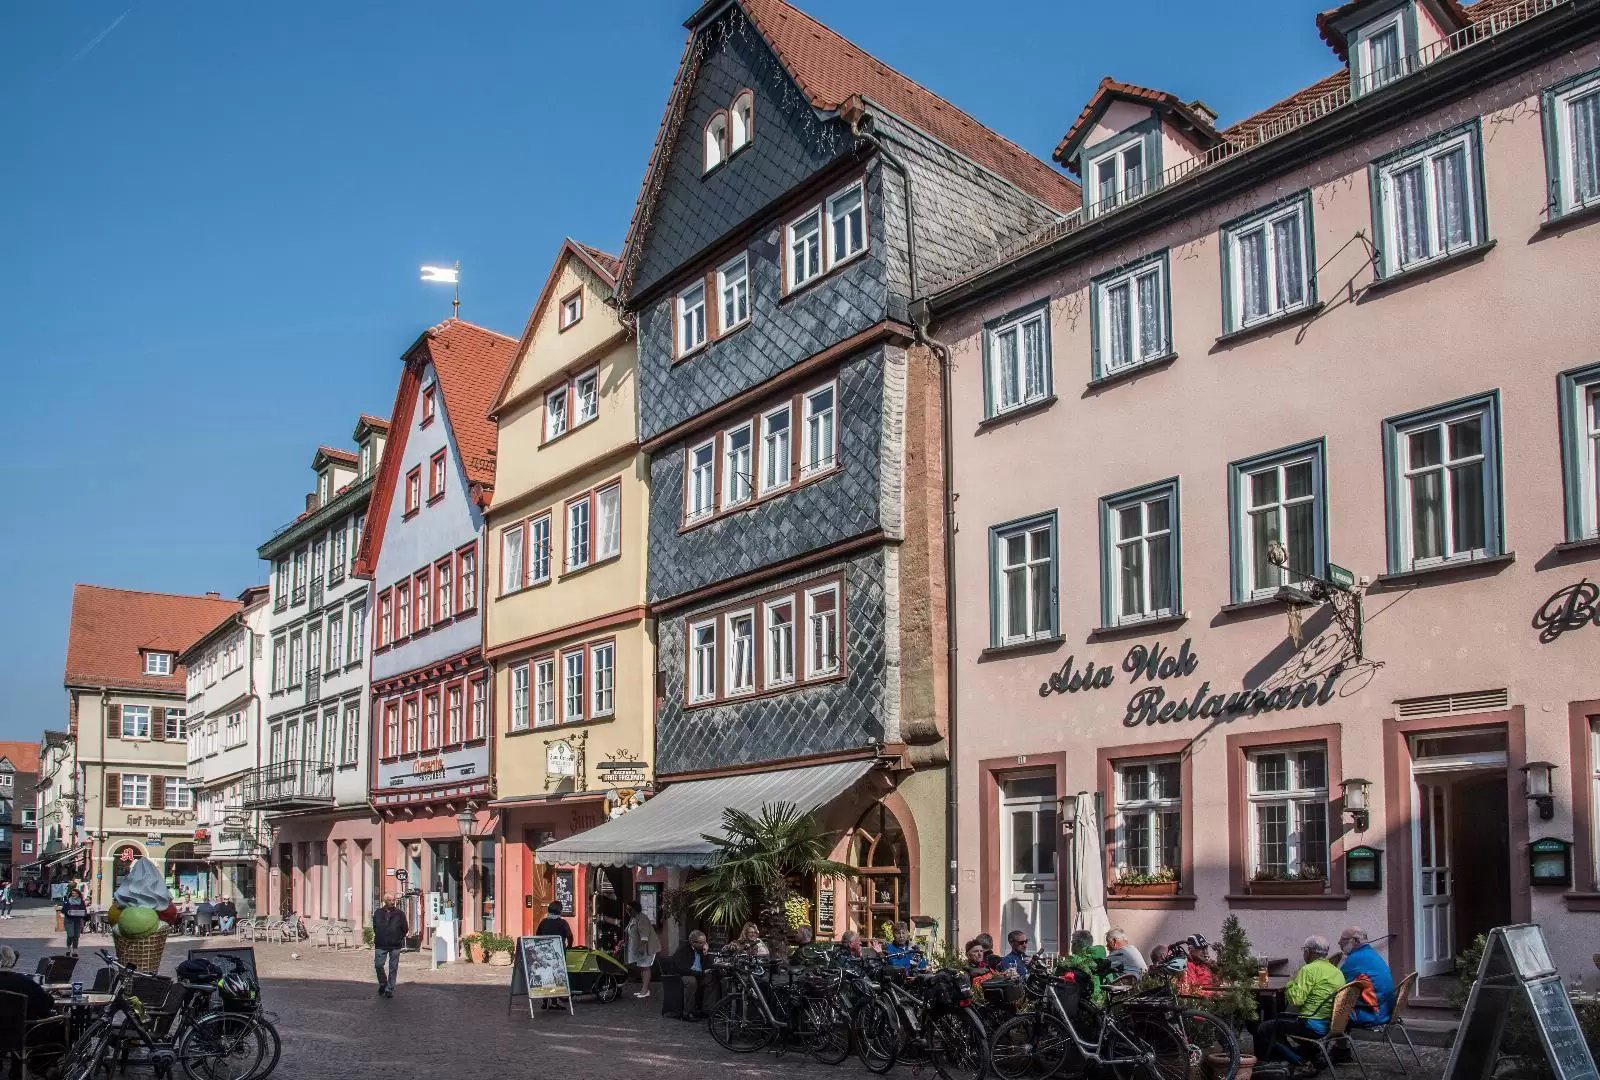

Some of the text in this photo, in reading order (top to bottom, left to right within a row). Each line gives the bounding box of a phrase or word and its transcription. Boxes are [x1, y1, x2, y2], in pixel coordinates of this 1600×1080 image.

[1039, 638, 1199, 697] Asia Wok
[1122, 665, 1343, 728] Restaurant
[126, 814, 186, 828] Hof Apotheke
[570, 809, 596, 832] Zum
